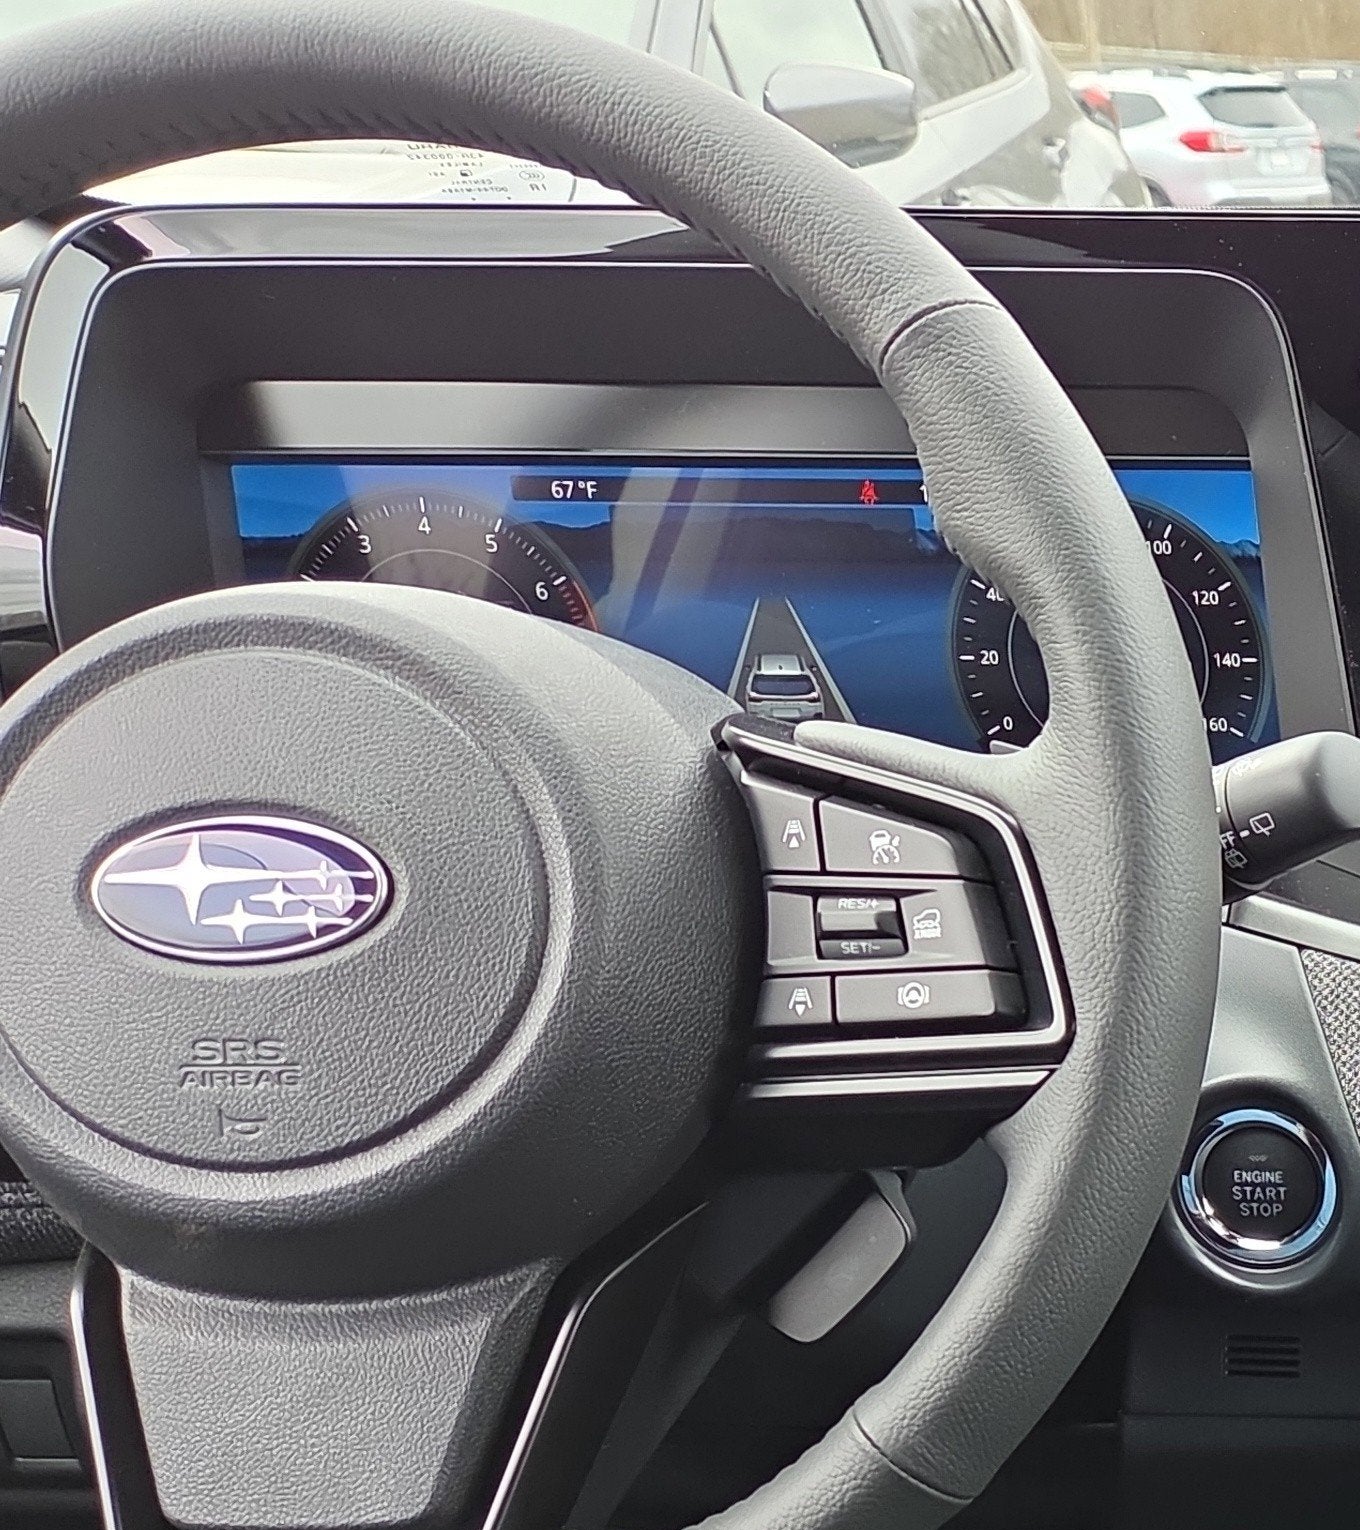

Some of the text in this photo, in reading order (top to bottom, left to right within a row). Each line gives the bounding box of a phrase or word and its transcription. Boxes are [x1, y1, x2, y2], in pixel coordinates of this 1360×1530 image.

[418, 516, 431, 535] 4
[358, 535, 372, 554] 3
[485, 534, 498, 552] 5
[535, 582, 549, 601] 6
[1192, 590, 1219, 605] 120
[980, 651, 999, 665] 20
[1214, 653, 1241, 667] 140
[1003, 717, 1013, 731] 0
[191, 1037, 286, 1063] SRS
[179, 1069, 301, 1088] AIRBAG
[1233, 1170, 1284, 1183] ENGINE
[1232, 1185, 1287, 1200] START
[1239, 1202, 1283, 1217] STOP
